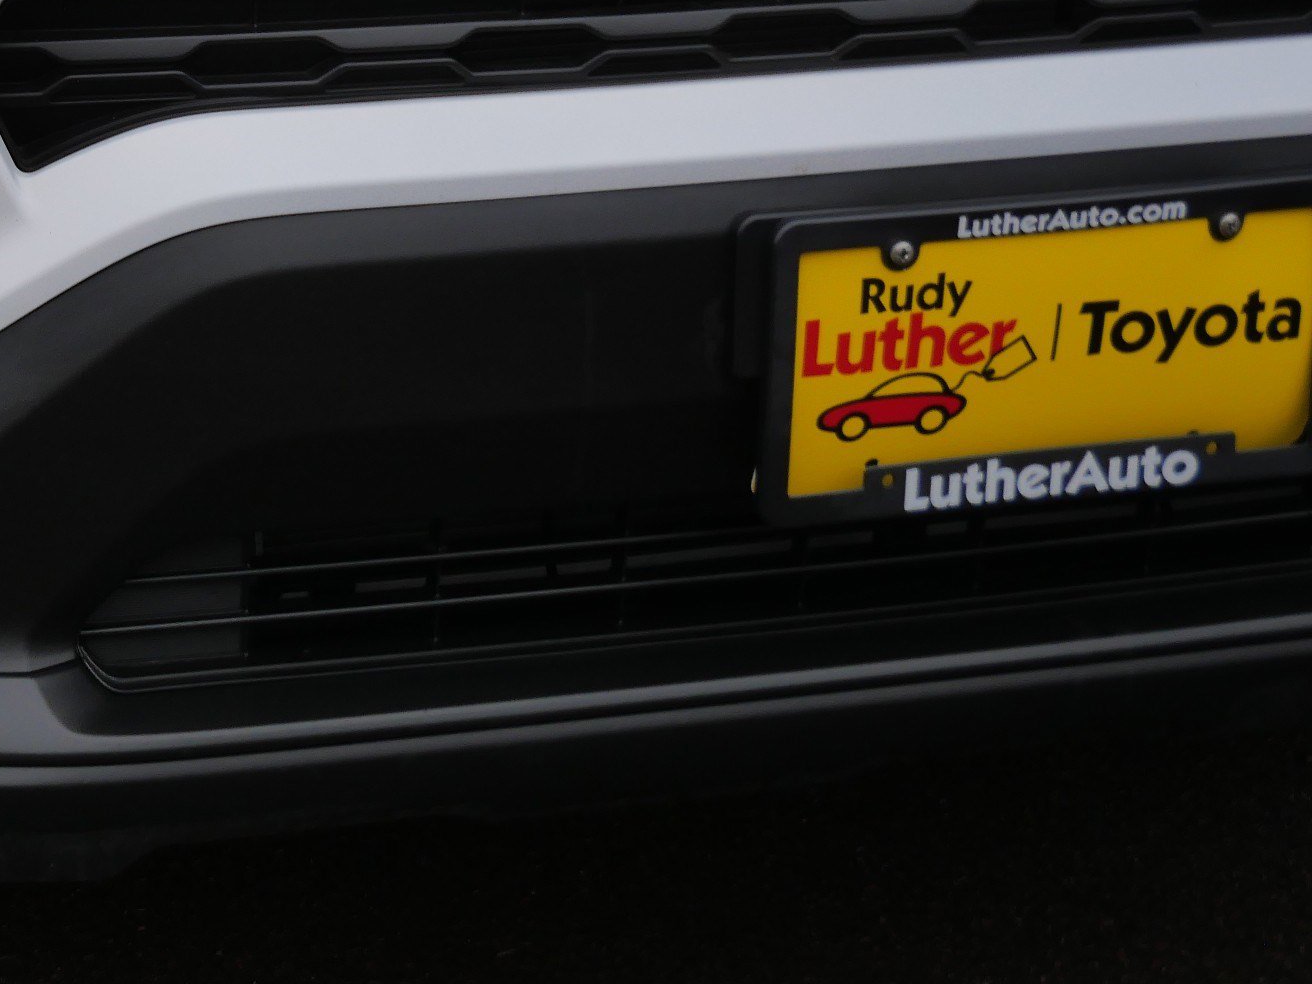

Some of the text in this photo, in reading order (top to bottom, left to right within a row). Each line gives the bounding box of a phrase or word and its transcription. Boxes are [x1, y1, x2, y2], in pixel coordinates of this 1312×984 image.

[957, 201, 1186, 239] LutherAuto.com
[860, 273, 972, 316] Rudy
[801, 289, 1302, 378] Luther Toyota
[903, 446, 1199, 512] LutherAuto
